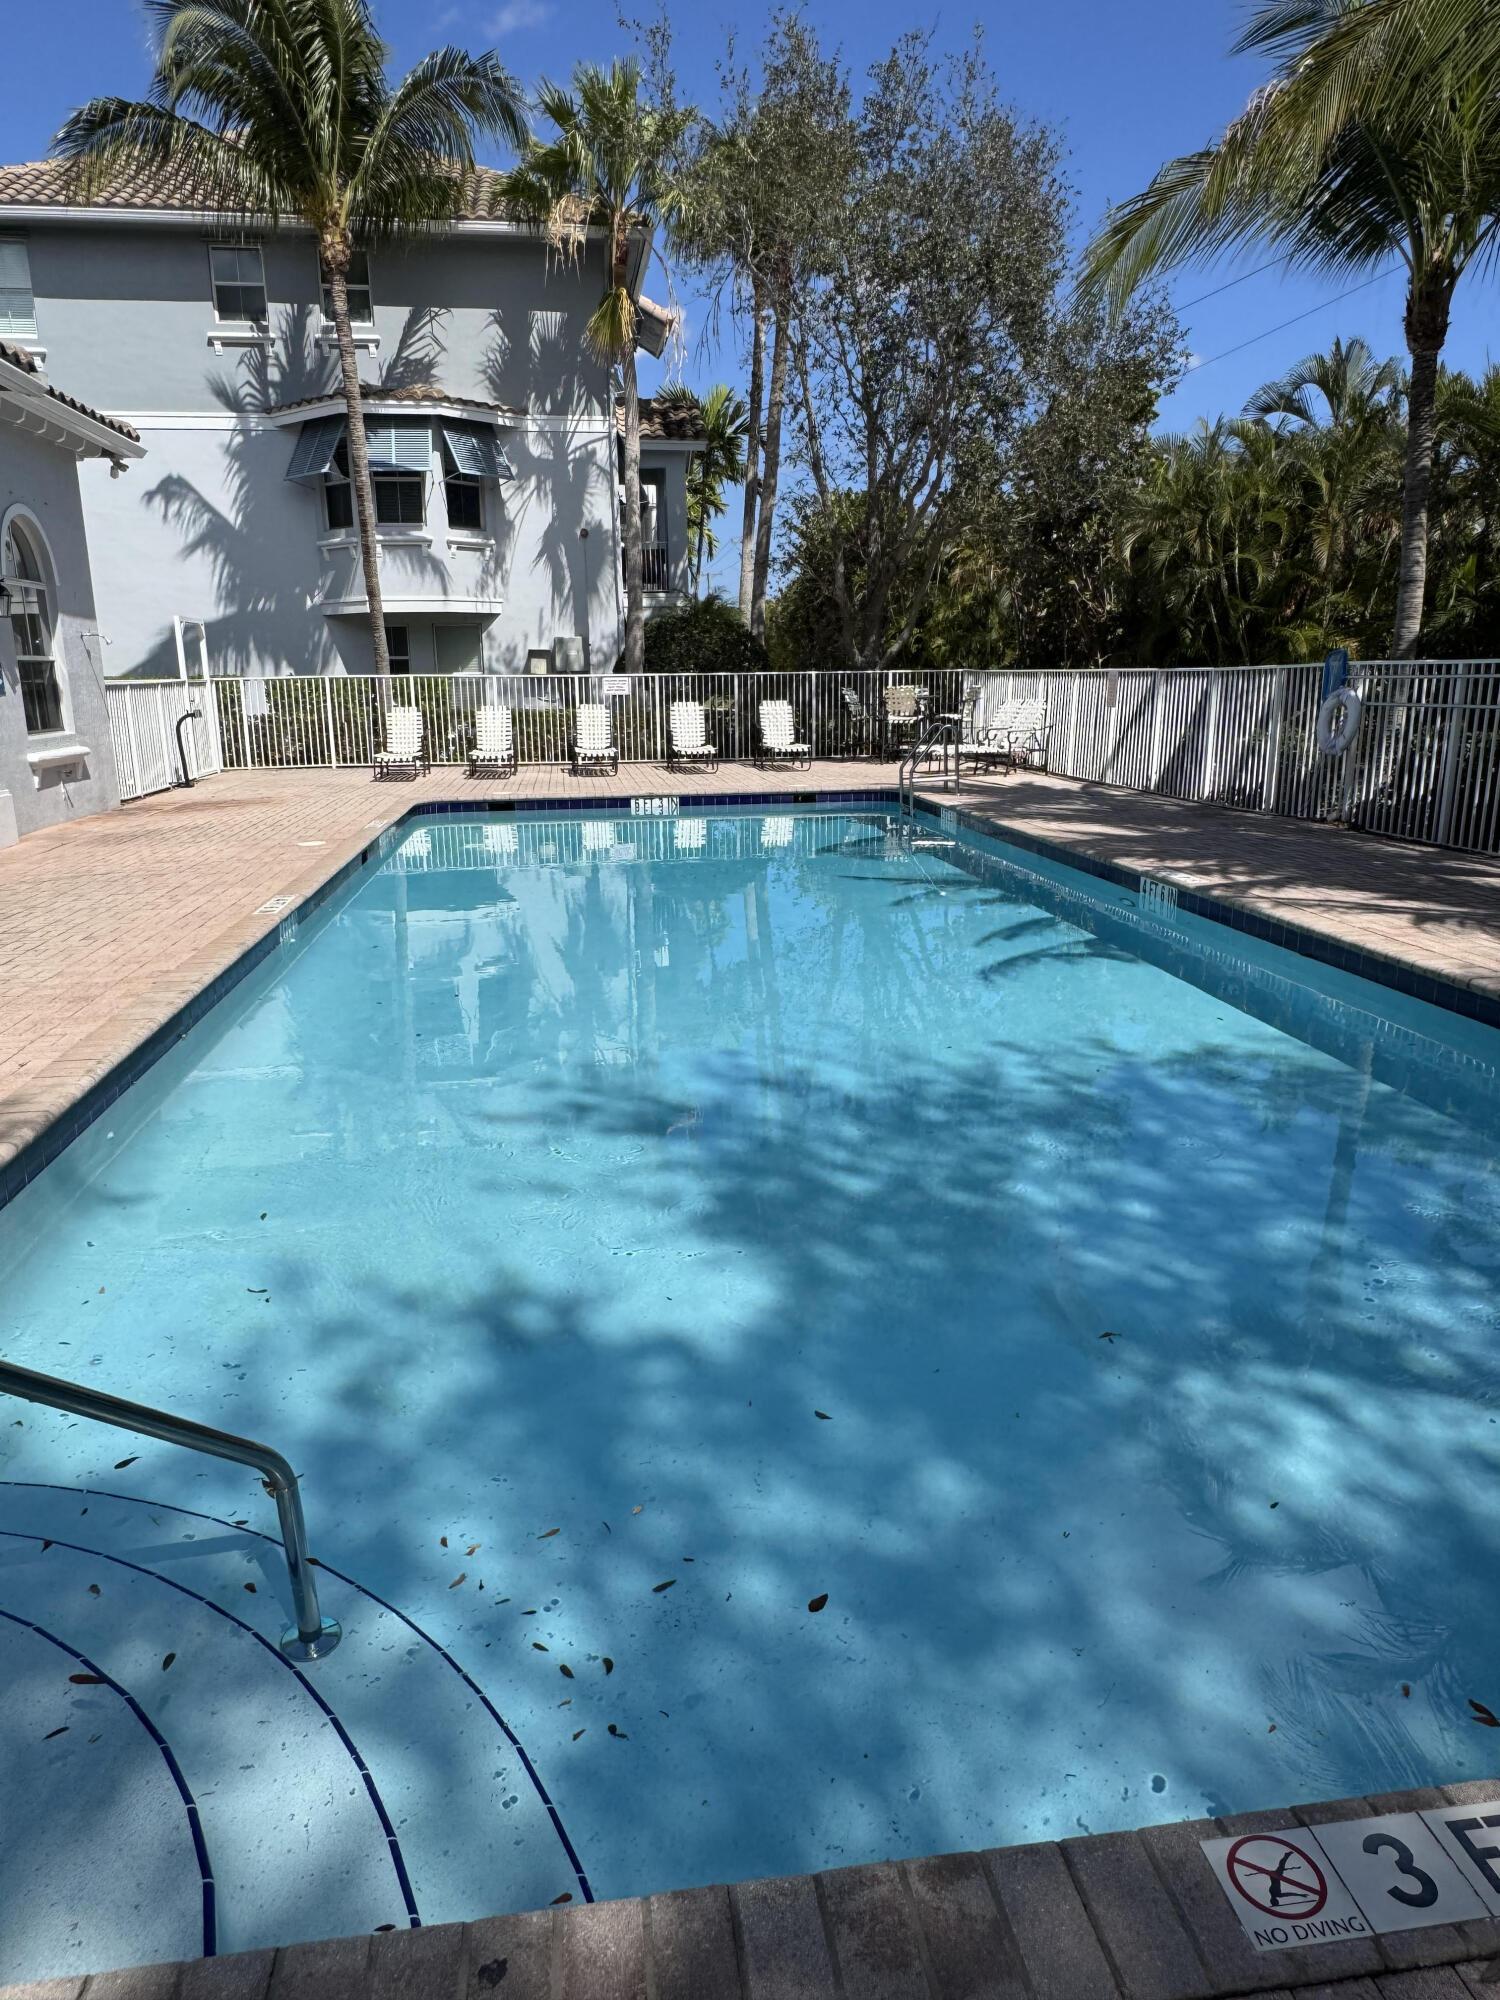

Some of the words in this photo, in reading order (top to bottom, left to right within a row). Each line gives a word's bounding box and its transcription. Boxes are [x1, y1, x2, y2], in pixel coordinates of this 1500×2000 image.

[1142, 879, 1147, 894] 4
[1149, 881, 1159, 899] FT
[1161, 885, 1165, 902] 6
[1168, 887, 1177, 906] IN
[1363, 1833, 1438, 1908] 3
[1445, 1815, 1500, 1894] F
[1254, 1926, 1288, 1947] NO
[1292, 1916, 1366, 1941] DIVING
